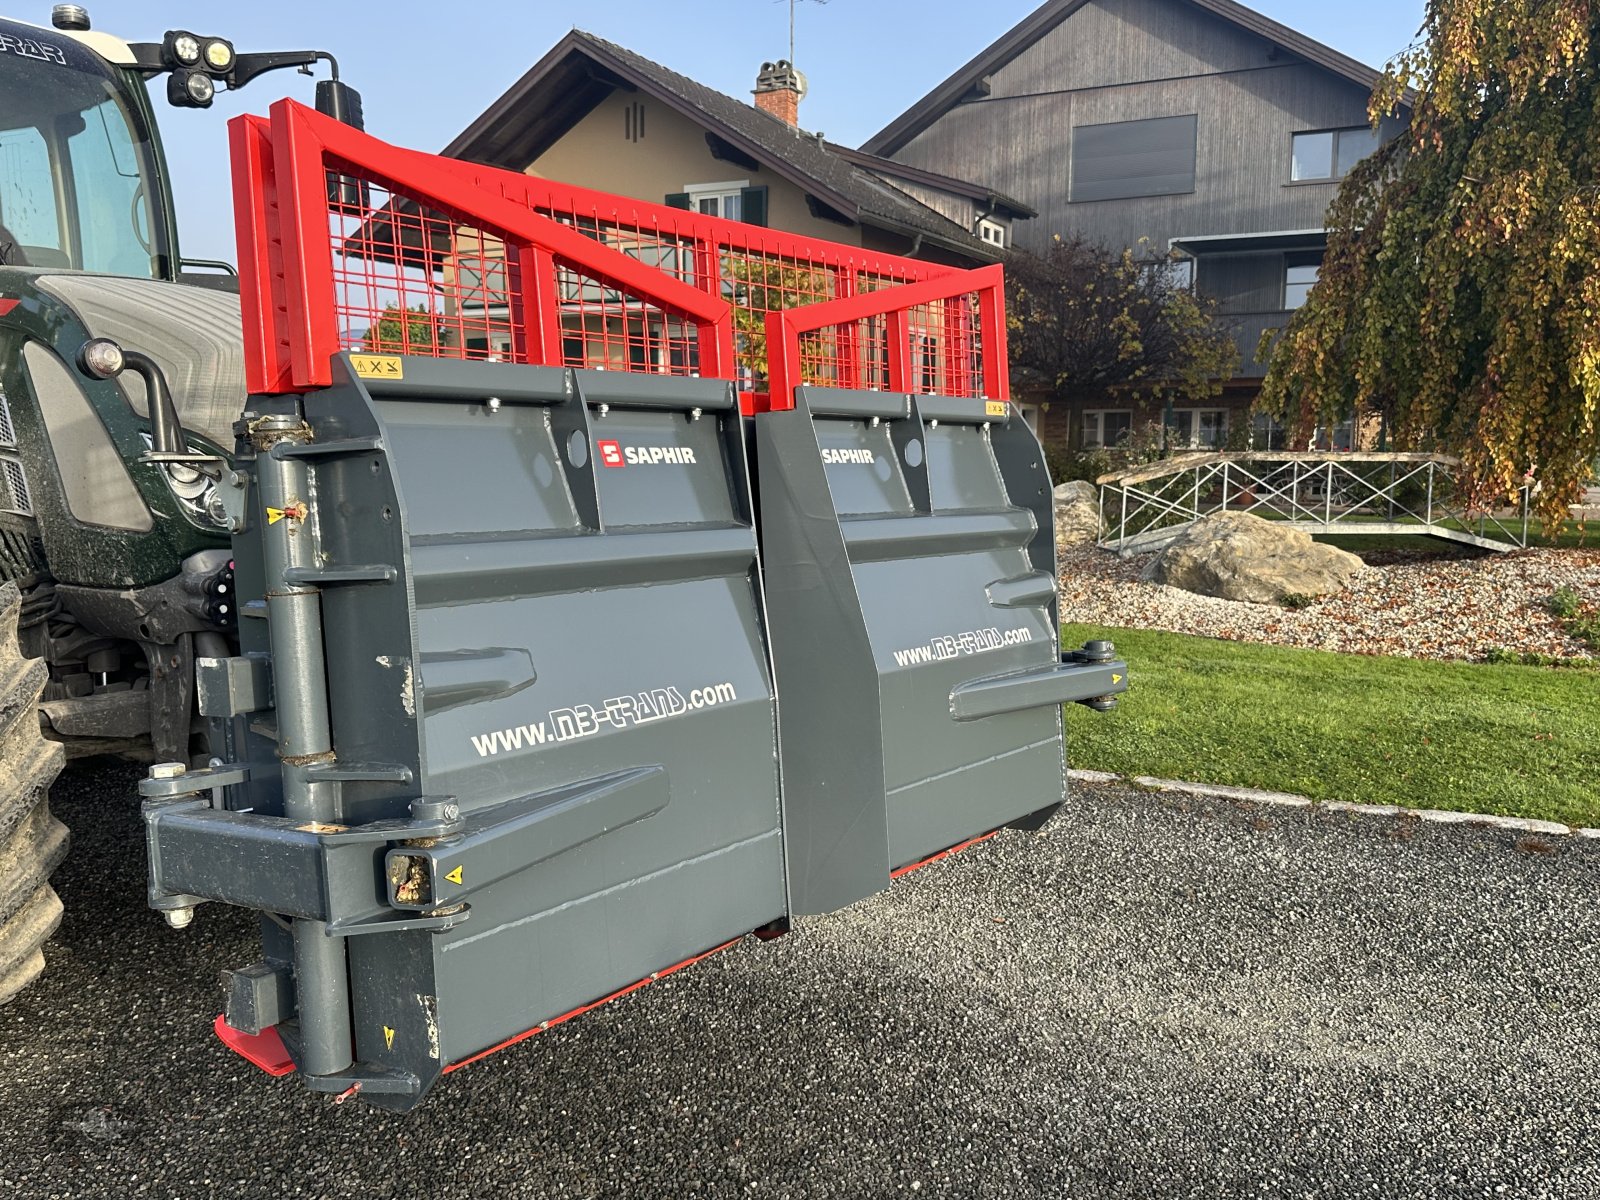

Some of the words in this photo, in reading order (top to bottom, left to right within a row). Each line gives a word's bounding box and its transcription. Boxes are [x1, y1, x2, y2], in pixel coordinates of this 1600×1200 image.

[0, 33, 66, 65] RAR
[624, 446, 697, 464] SAPHIR
[821, 448, 875, 464] SAPHIR
